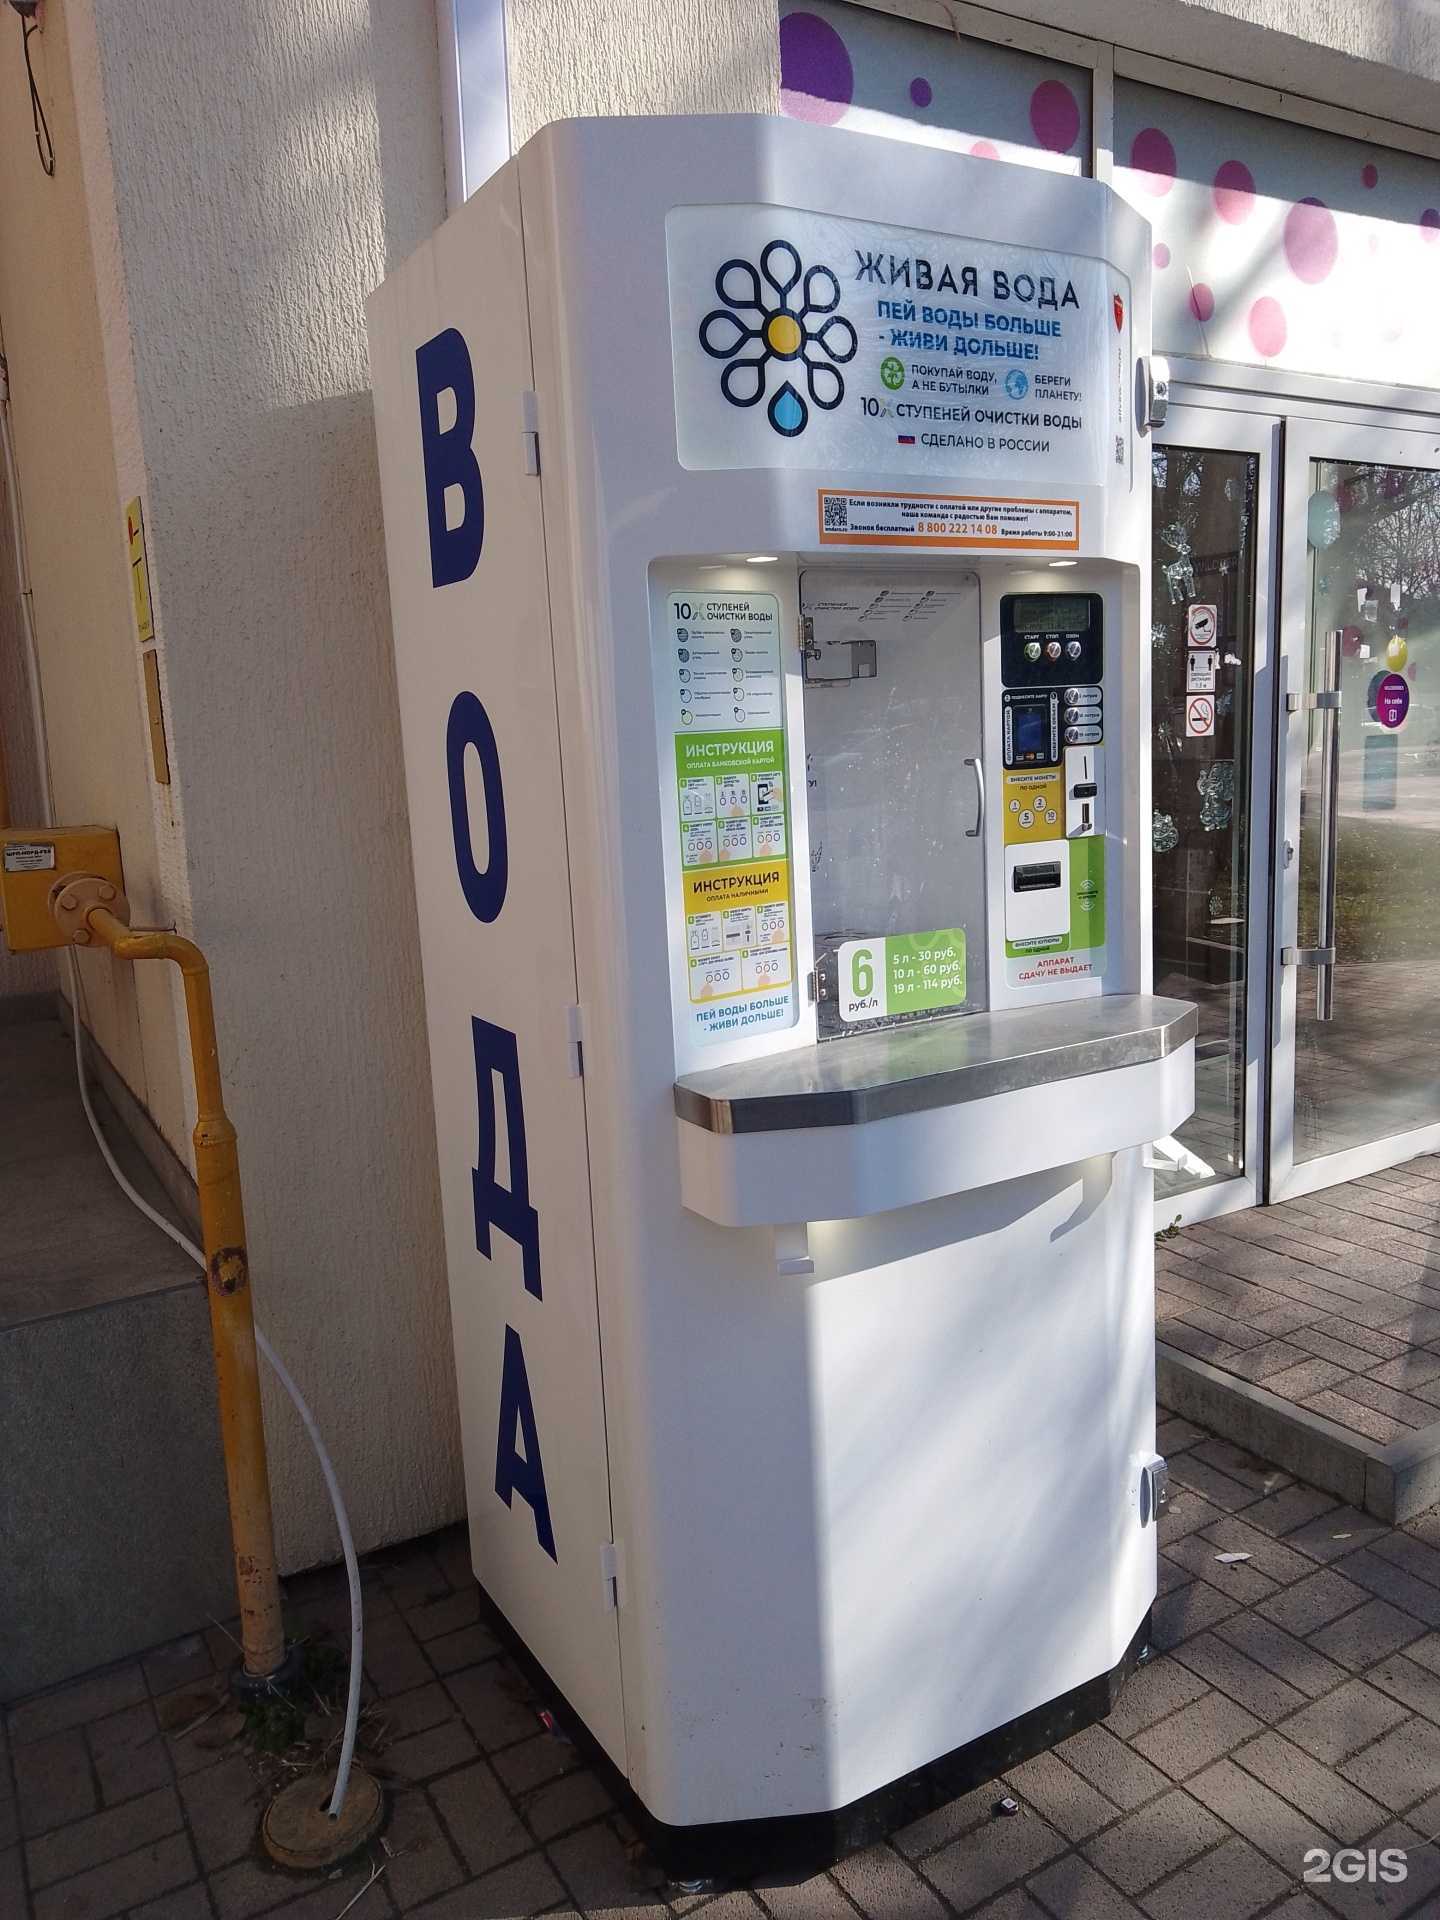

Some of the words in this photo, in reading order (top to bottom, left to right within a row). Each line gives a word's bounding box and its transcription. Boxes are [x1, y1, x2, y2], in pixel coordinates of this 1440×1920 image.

[854, 250, 978, 297] ЖИВАЯ
[993, 270, 1080, 311] ВОДА
[877, 299, 916, 322] ПЕЙ
[922, 306, 978, 330] ВОДЫ
[984, 314, 1062, 337] БОЛЬШЕ
[890, 328, 949, 352] ЖИВИ
[953, 336, 1040, 360] ДОЛЬШЕ!
[911, 363, 963, 381] ПОКУПАЙ
[966, 369, 997, 385] ВОДУ,
[1035, 374, 1071, 387] БЕРЕГИ
[911, 380, 920, 390] А
[922, 381, 936, 392] НЕ
[939, 382, 989, 396] БУТЫЛКИ
[1035, 389, 1081, 402] ПЛАНЕТУ!
[896, 402, 970, 422] СТУПЕНЕЙ
[975, 409, 1039, 426] ОЧИСТКИ
[1043, 414, 1082, 430] ВОДЫ
[921, 433, 982, 449] СДЕЛАНО
[987, 438, 995, 449] В
[1000, 439, 1050, 452] РОССИИ
[849, 498, 865, 507] Если
[866, 500, 899, 508] возникли
[900, 502, 934, 511] трудности
[980, 506, 1002, 514] другие
[1002, 506, 1034, 514] проблемы
[850, 523, 874, 531] Звонок
[875, 523, 915, 532] бесплатный
[918, 522, 924, 532] 8
[927, 522, 946, 533] 800
[949, 523, 968, 533] 222
[971, 524, 982, 534] 14
[985, 524, 997, 534] 08
[1021, 529, 1042, 537] работы
[706, 602, 750, 611] СТУПЕНЕЙ
[707, 612, 747, 621] ОЧИСТКИ
[748, 613, 773, 621] ВОДЫ
[686, 741, 774, 757] ИНСТРУКЦИЯ
[1024, 812, 1029, 820] 5
[693, 871, 779, 894] ИНСТРУКЦИЯ
[706, 893, 730, 902] ОПЛАТА
[731, 888, 768, 898] НАЛИЧНЫМИ
[416, 328, 557, 1562] ВОДА
[893, 954, 900, 964] 5
[902, 954, 909, 962] л
[918, 950, 931, 961] 30
[934, 946, 956, 961] руб.
[1037, 957, 1074, 967] АППАРАТ
[852, 949, 873, 997] 6
[893, 969, 905, 980] 10
[907, 969, 914, 977] л
[923, 965, 937, 975] 60
[940, 961, 960, 974] руб.
[1019, 970, 1046, 980] СДАЧУ
[1048, 968, 1057, 976] НЕ
[1059, 963, 1092, 974] ВЫДАЕТ
[893, 983, 905, 994] 19
[907, 984, 914, 992] л
[923, 979, 938, 990] 114
[941, 975, 962, 989] руб.
[696, 1009, 716, 1022] ПЕЙ
[718, 1003, 747, 1017] ВОДЫ
[750, 996, 789, 1010] БОЛЬШЕ
[849, 998, 878, 1012] руб./л
[709, 1018, 738, 1031] ЖИВИ
[741, 1008, 784, 1026] ДОЛЬШЕ!
